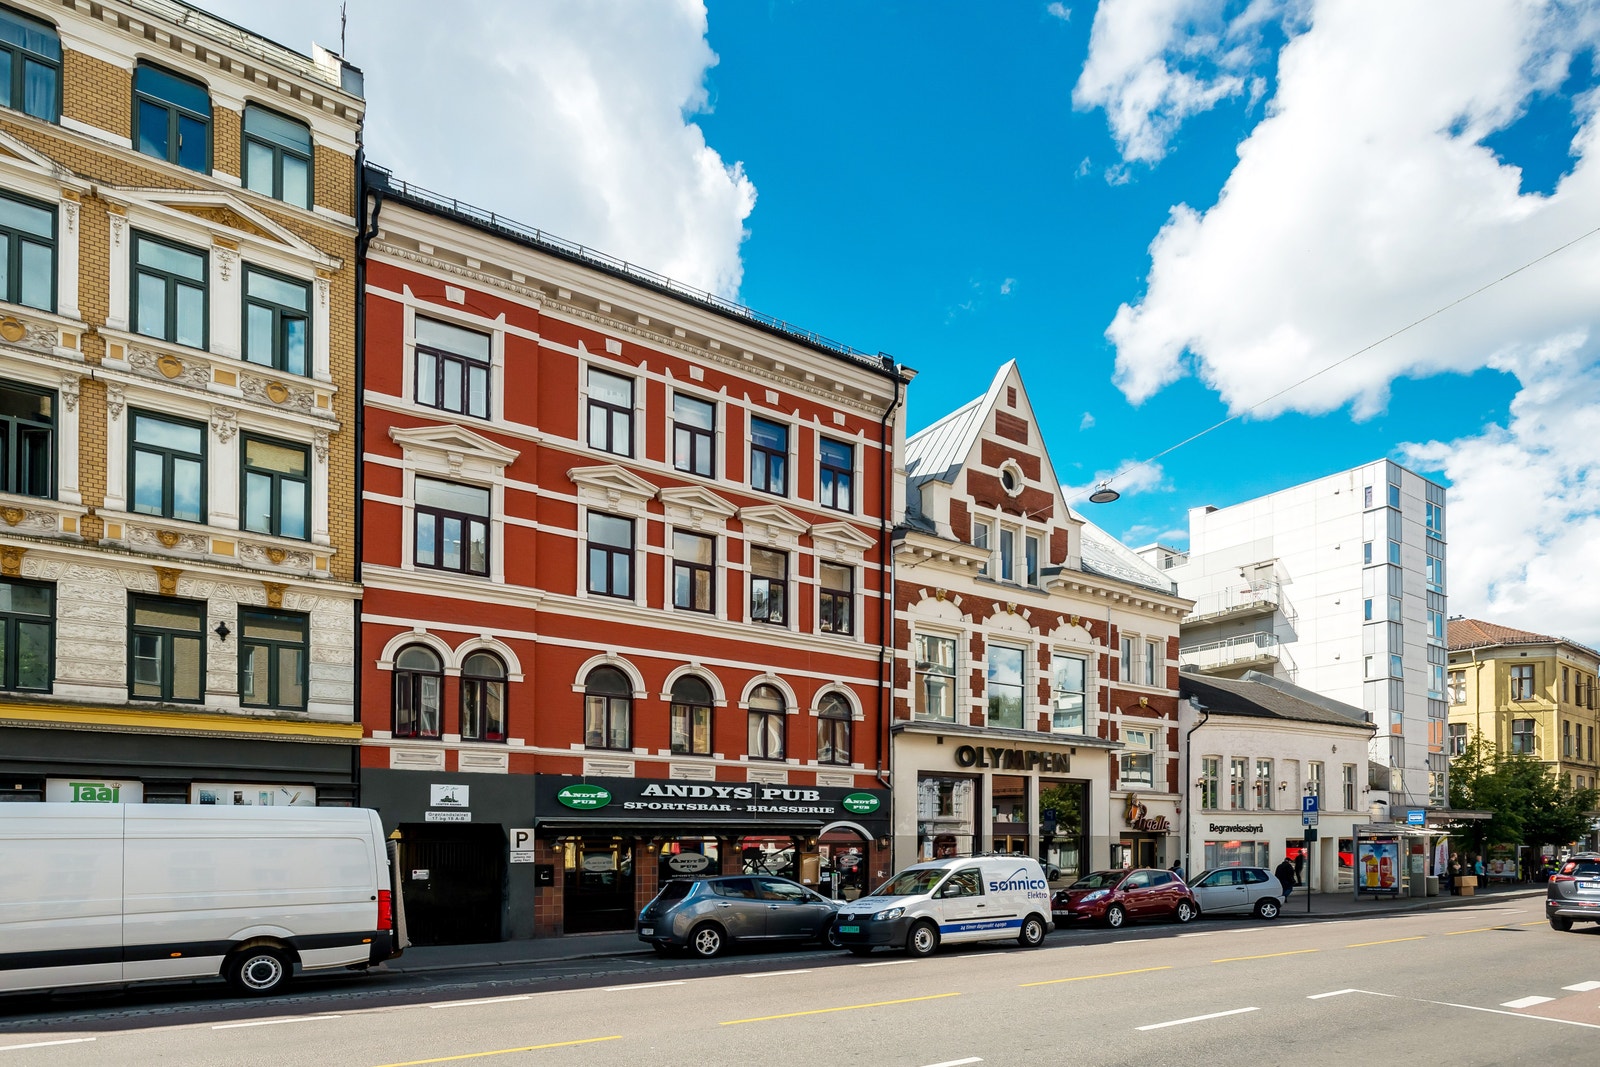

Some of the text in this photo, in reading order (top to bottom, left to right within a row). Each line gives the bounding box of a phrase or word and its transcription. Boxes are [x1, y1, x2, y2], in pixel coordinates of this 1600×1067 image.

[955, 745, 1071, 773] OLYMPEN
[641, 783, 820, 801] ANDYS PUB
[623, 801, 732, 812] SPORTSBAR
[746, 804, 835, 814] BRASSERIE
[1306, 798, 1315, 810] P
[1209, 823, 1263, 834] Begravelsesbyrå
[516, 831, 529, 848] P
[1027, 891, 1048, 899] Elektro
